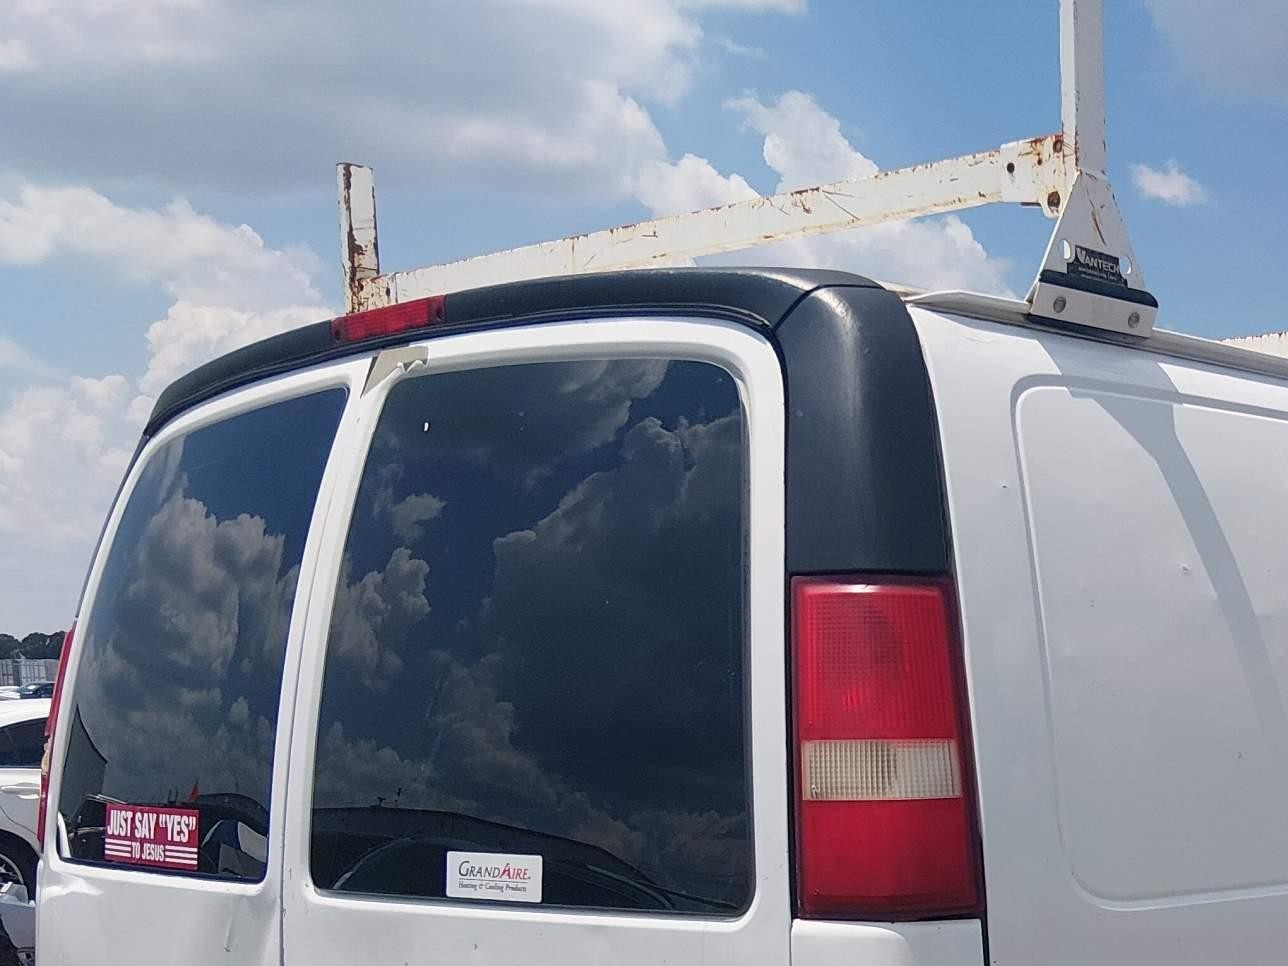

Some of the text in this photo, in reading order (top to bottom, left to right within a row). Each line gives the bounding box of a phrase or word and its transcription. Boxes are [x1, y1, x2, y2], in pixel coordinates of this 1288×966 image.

[1076, 247, 1120, 274] VANTECH
[107, 809, 133, 837] JUST
[134, 812, 157, 840] SAY
[132, 841, 165, 862] TO JESUS
